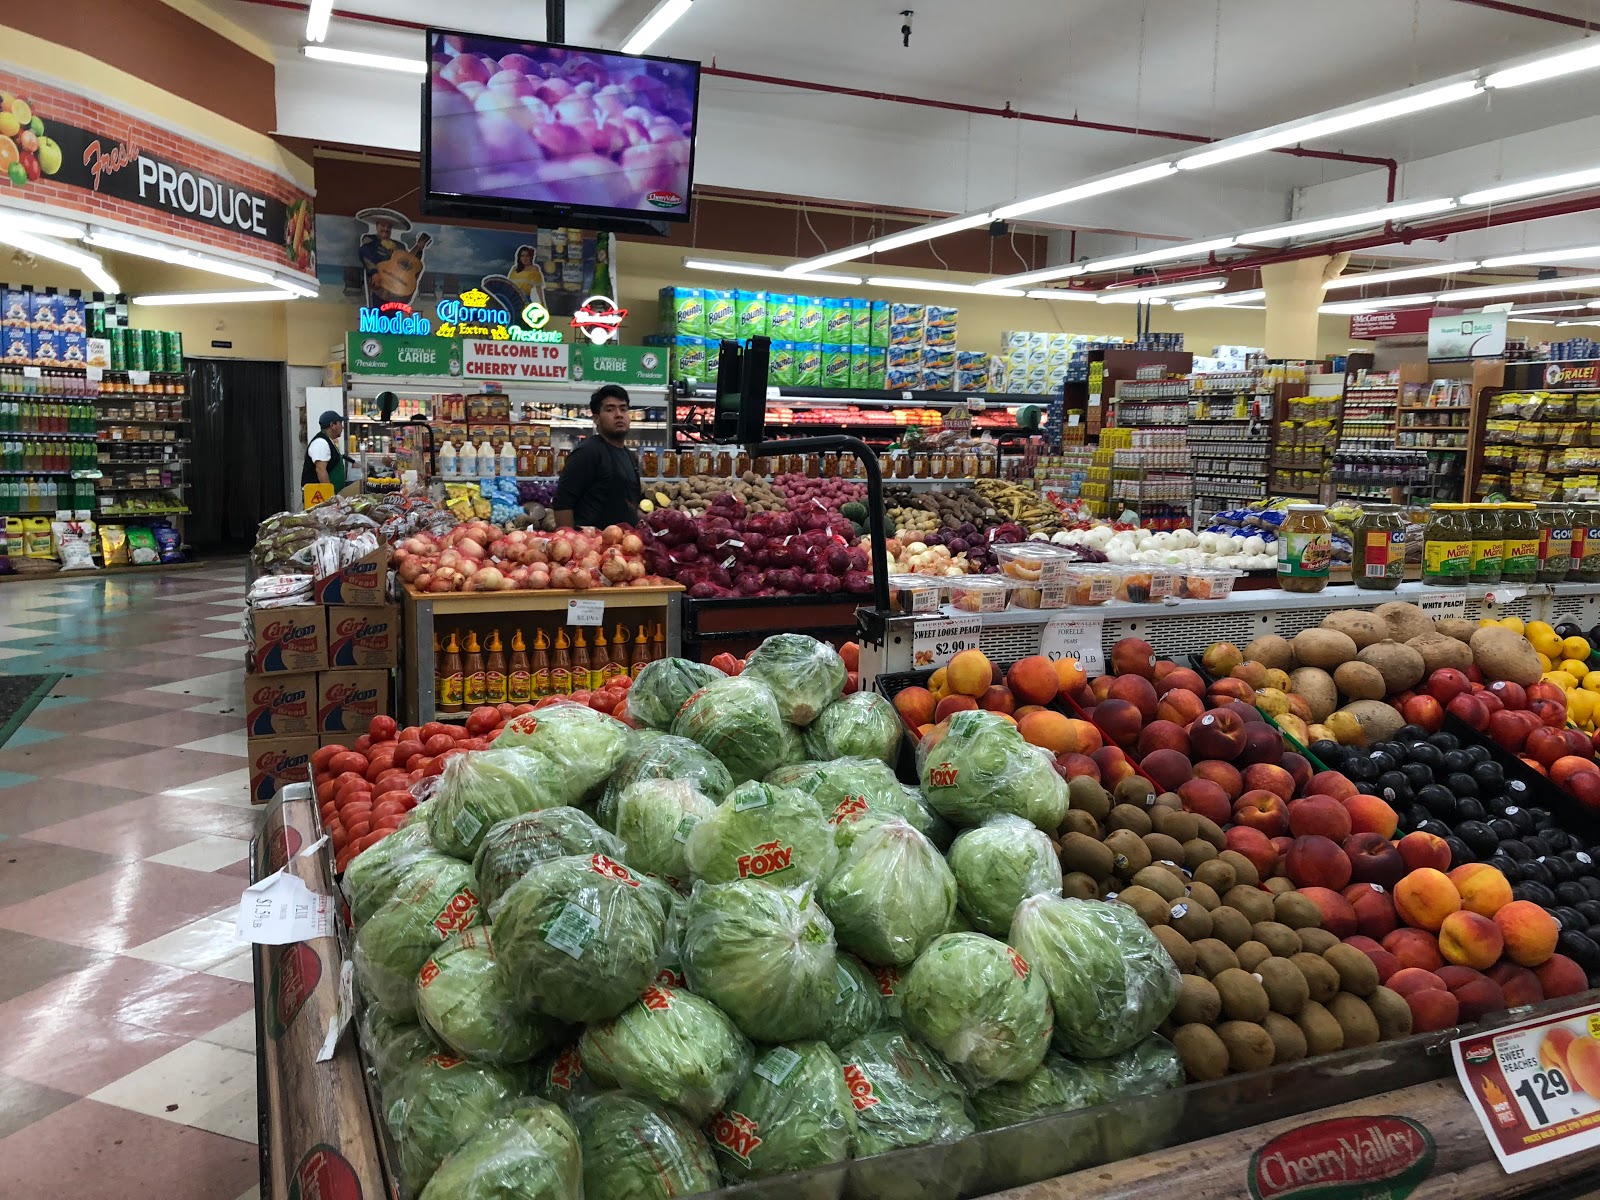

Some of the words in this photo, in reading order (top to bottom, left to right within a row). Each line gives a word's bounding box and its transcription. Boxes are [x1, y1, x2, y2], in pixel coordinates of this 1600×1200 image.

[84, 125, 139, 191] Fresh
[138, 155, 267, 237] PRODUCE
[436, 299, 509, 325] Corona
[677, 304, 703, 323] Bounty
[709, 306, 733, 325] Bounty
[742, 307, 765, 325] Bounty
[800, 312, 821, 329] Bounty
[1353, 313, 1397, 322] McCormick
[359, 307, 431, 336] Modelo
[459, 323, 489, 335] Extra
[827, 315, 852, 332] Bounty
[508, 325, 563, 343] Presidente
[398, 352, 436, 364] CARIBE
[474, 343, 537, 359] WELCOME
[540, 345, 559, 360] TO
[355, 358, 388, 369] Presidente
[466, 361, 519, 376] CHERRY
[521, 363, 567, 379] VALLEY
[593, 361, 627, 372] CARIBE
[348, 576, 375, 587] Bread
[1443, 600, 1463, 608] PEACH
[914, 629, 936, 639] SWEET
[937, 627, 958, 637] LOOSE
[960, 625, 981, 635] PEACH
[360, 640, 386, 648] Bread
[936, 640, 964, 656] $2.99
[278, 708, 304, 716] Bread
[929, 767, 959, 787] FOXY
[737, 846, 794, 878] FOXY
[254, 898, 272, 919] $1.59
[433, 886, 479, 940] FOXY
[253, 918, 262, 928] LB
[1500, 1048, 1526, 1063] SWEET
[1503, 1057, 1538, 1073] PEACHES
